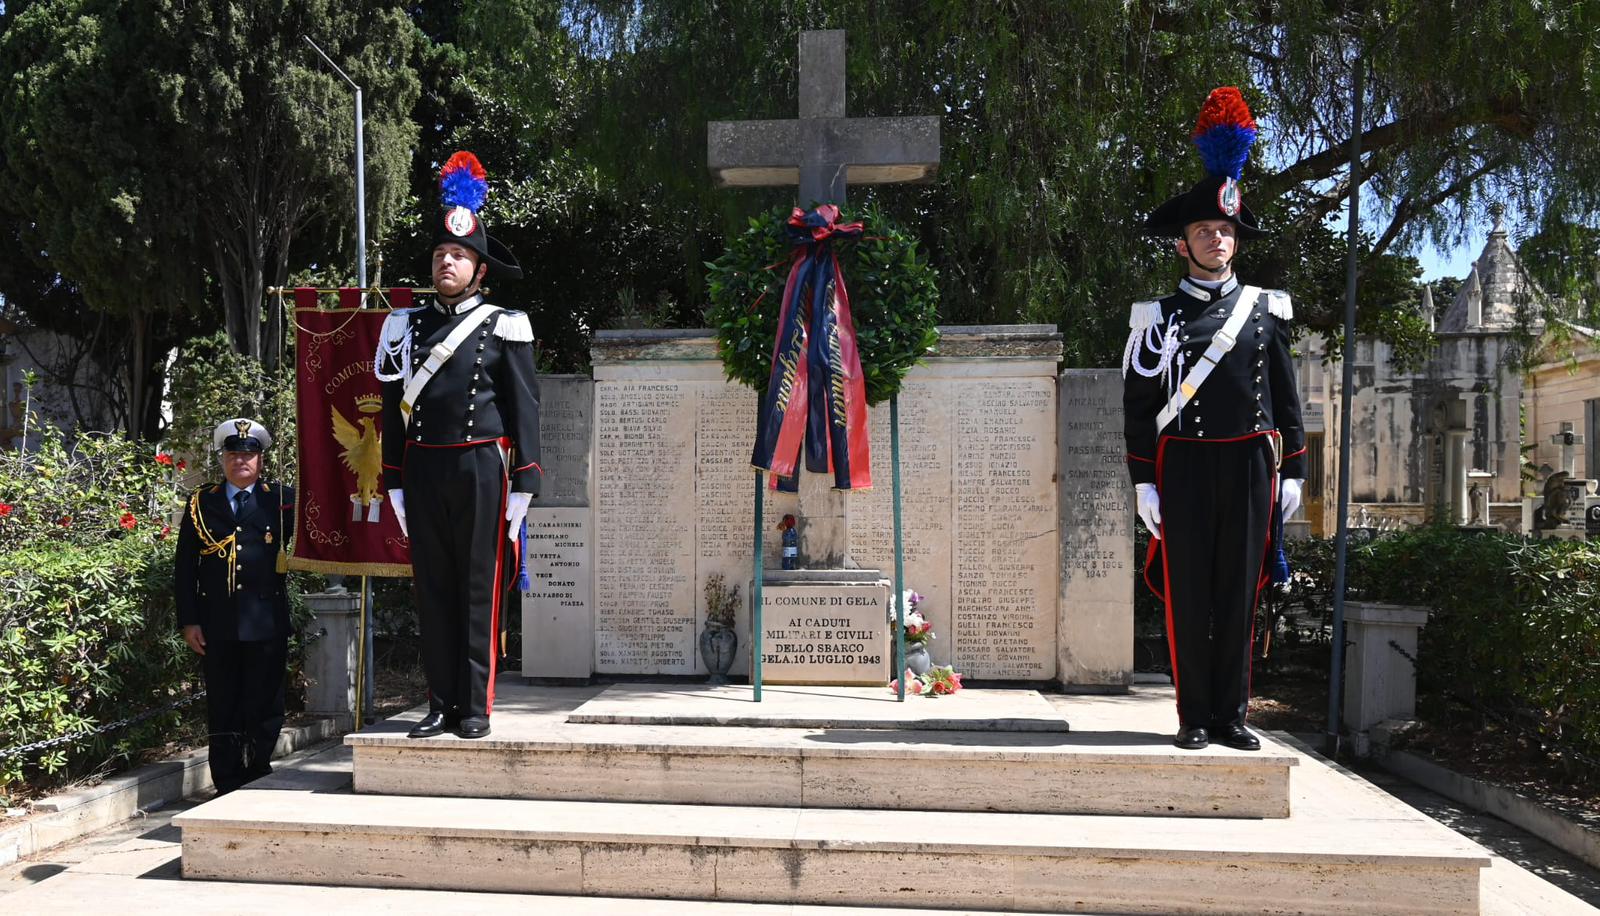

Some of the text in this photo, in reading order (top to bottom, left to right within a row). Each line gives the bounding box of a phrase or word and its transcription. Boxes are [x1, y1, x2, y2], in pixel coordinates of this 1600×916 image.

[325, 361, 374, 395] COMUNE
[1068, 445, 1121, 455] PASSARELLO
[988, 469, 1032, 477] FRANCESCO
[1081, 501, 1129, 512] EMANUELA
[959, 588, 1034, 596] ASCIA FRANCESCO
[775, 597, 826, 606] COMUNE
[830, 597, 842, 606] DI
[846, 597, 878, 606] GELA
[957, 613, 998, 621] COSTANZO
[789, 618, 850, 628] AI CADUTI
[957, 621, 1034, 629] GUELI FRANCESCO
[767, 630, 873, 640] MILITARI E CIVILI
[957, 638, 1029, 646] MONACO GAETANO
[776, 643, 864, 653] DELLO SBARCO
[957, 646, 1037, 654] MASSARO SALVATORE
[809, 654, 854, 665] LUGLIO
[858, 654, 881, 665] 1943
[997, 654, 1031, 662] GIOVANNI
[1003, 661, 1043, 670] SALVATORE
